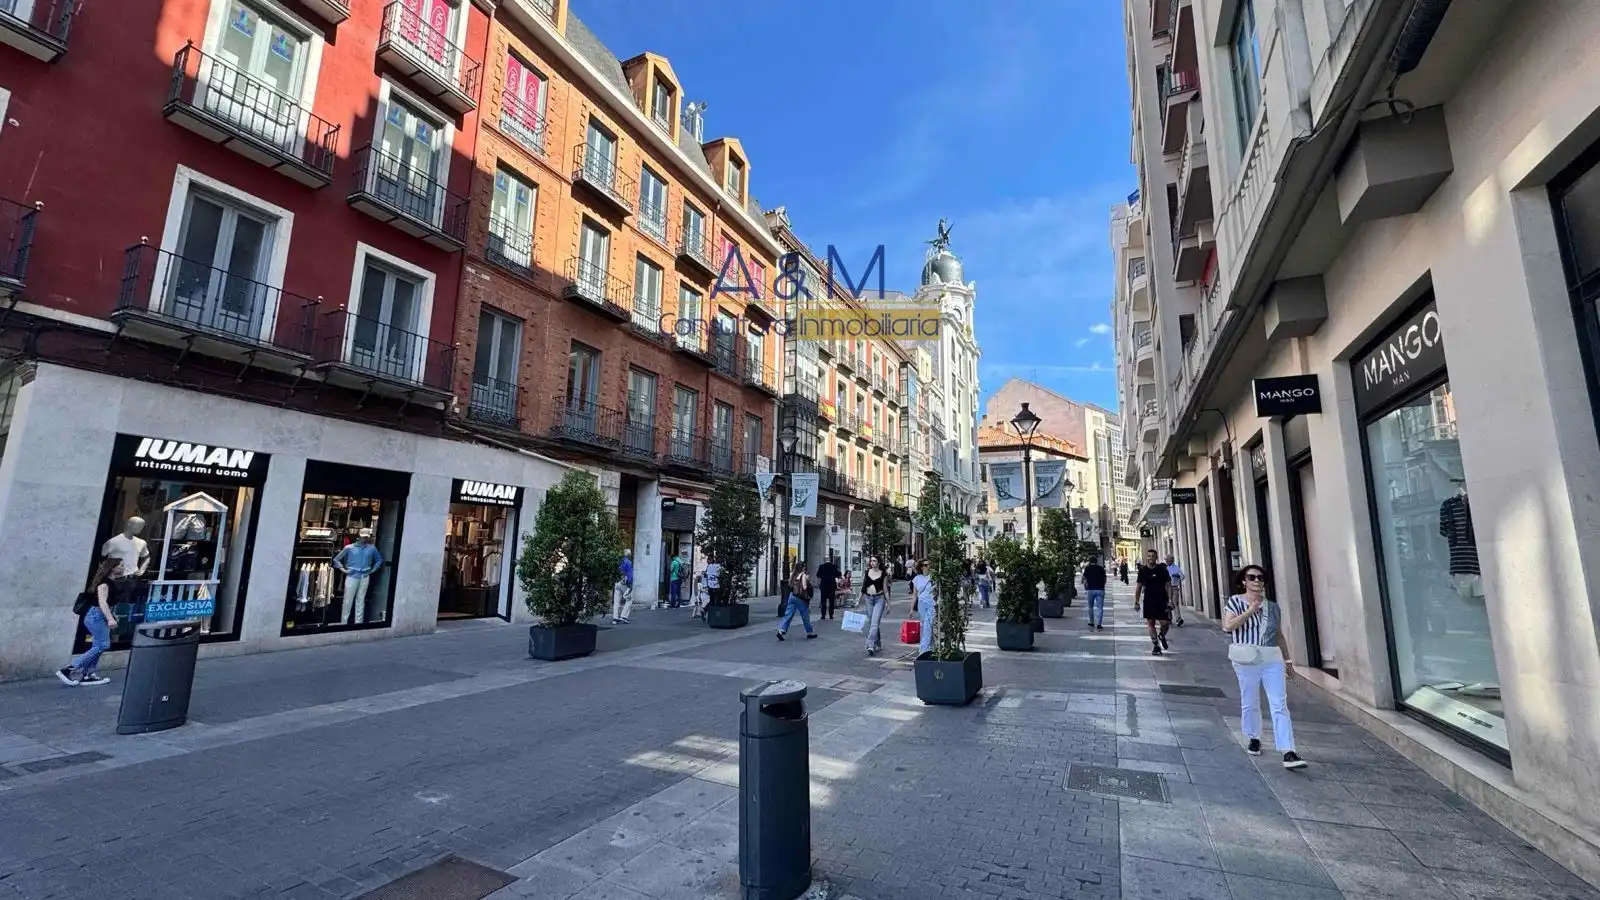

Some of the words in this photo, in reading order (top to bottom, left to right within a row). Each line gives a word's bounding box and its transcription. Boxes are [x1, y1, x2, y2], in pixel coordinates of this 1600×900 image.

[1363, 310, 1440, 390] MANGO
[1392, 370, 1410, 388] MAN
[1260, 388, 1315, 400] MANGO
[135, 437, 255, 470] IUMAN
[136, 460, 212, 475] intimissimi
[215, 469, 248, 478] uomo
[460, 480, 517, 500] IUMAN
[148, 601, 213, 612] EXCLUSIVA
